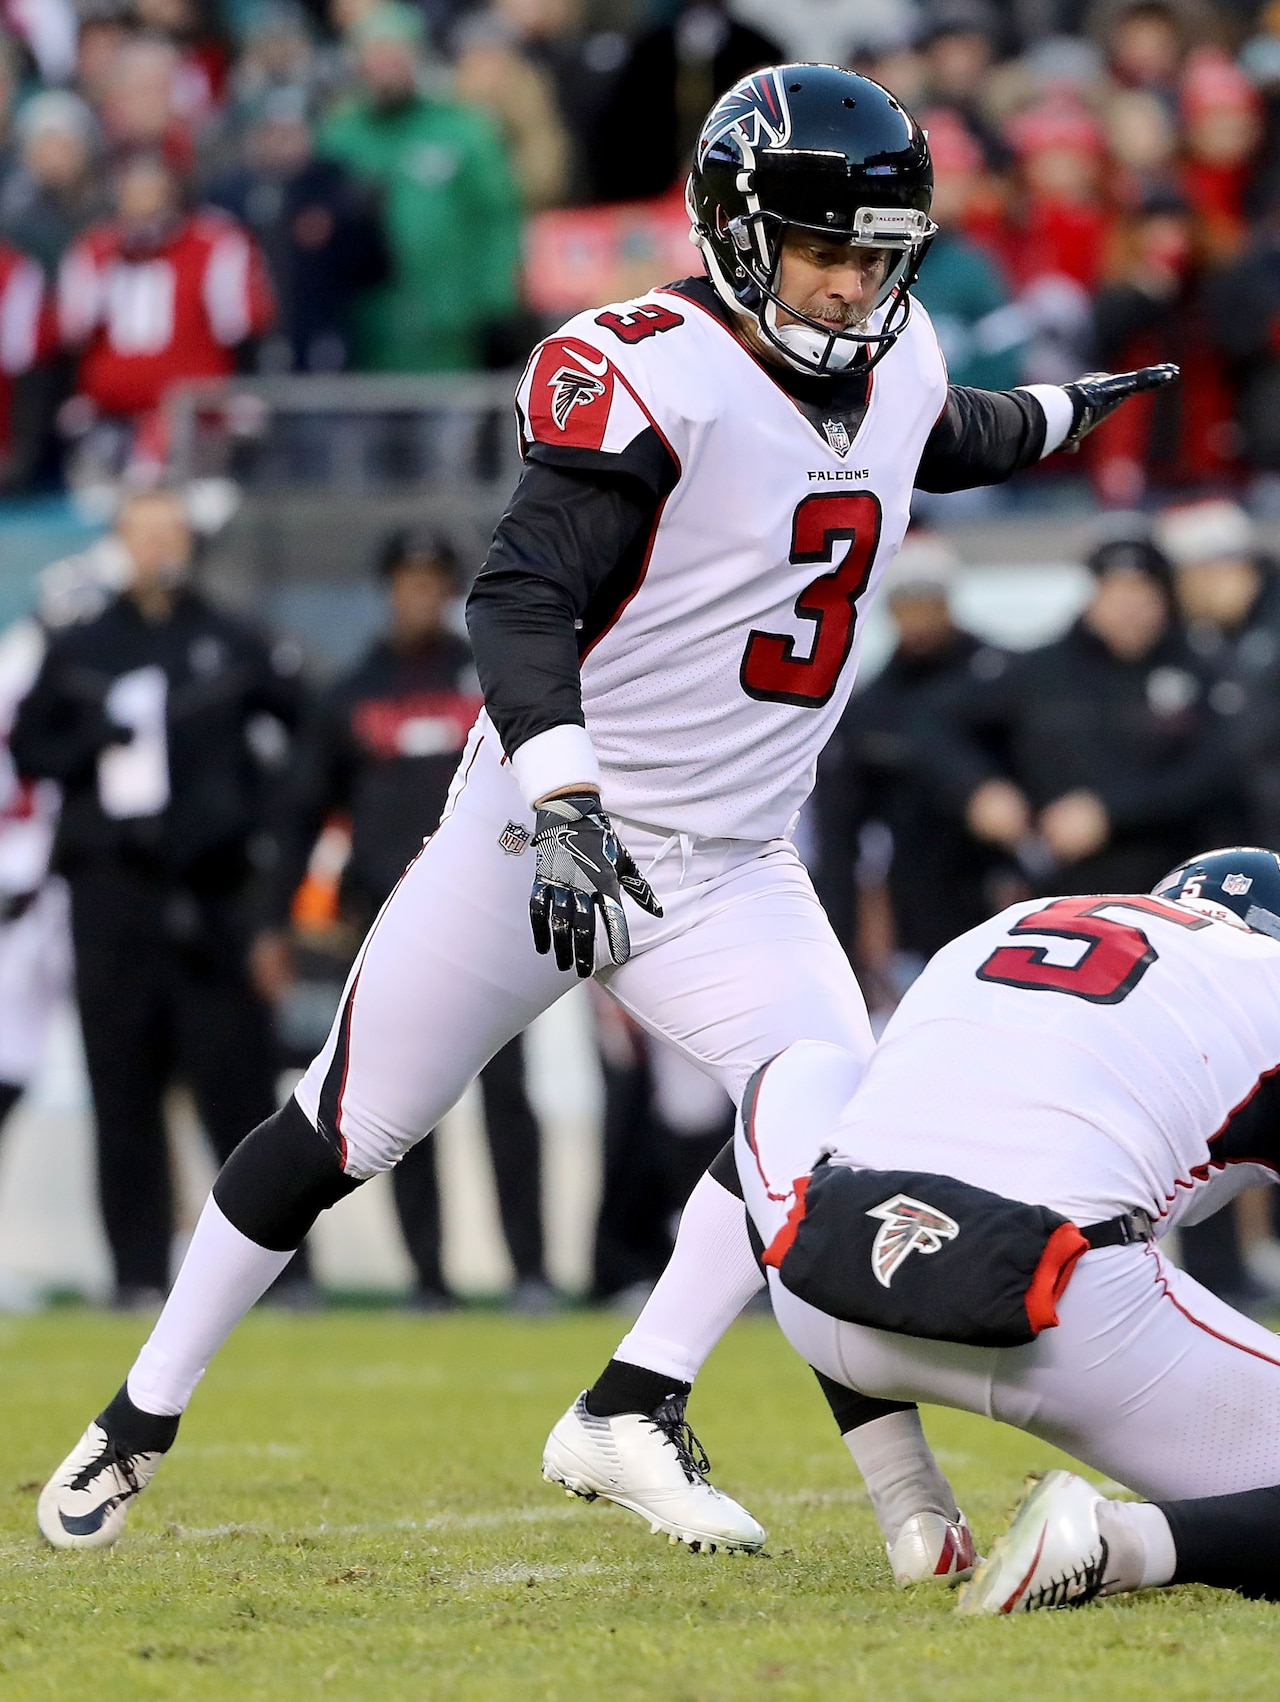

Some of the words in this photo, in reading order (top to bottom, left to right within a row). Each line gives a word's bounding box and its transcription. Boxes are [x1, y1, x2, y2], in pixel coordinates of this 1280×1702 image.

[594, 304, 685, 344] 3
[807, 469, 869, 481] FALCONS
[740, 490, 882, 708] 3
[502, 832, 524, 852] NFL
[1181, 875, 1207, 898] 5
[976, 896, 1213, 1004] 5
